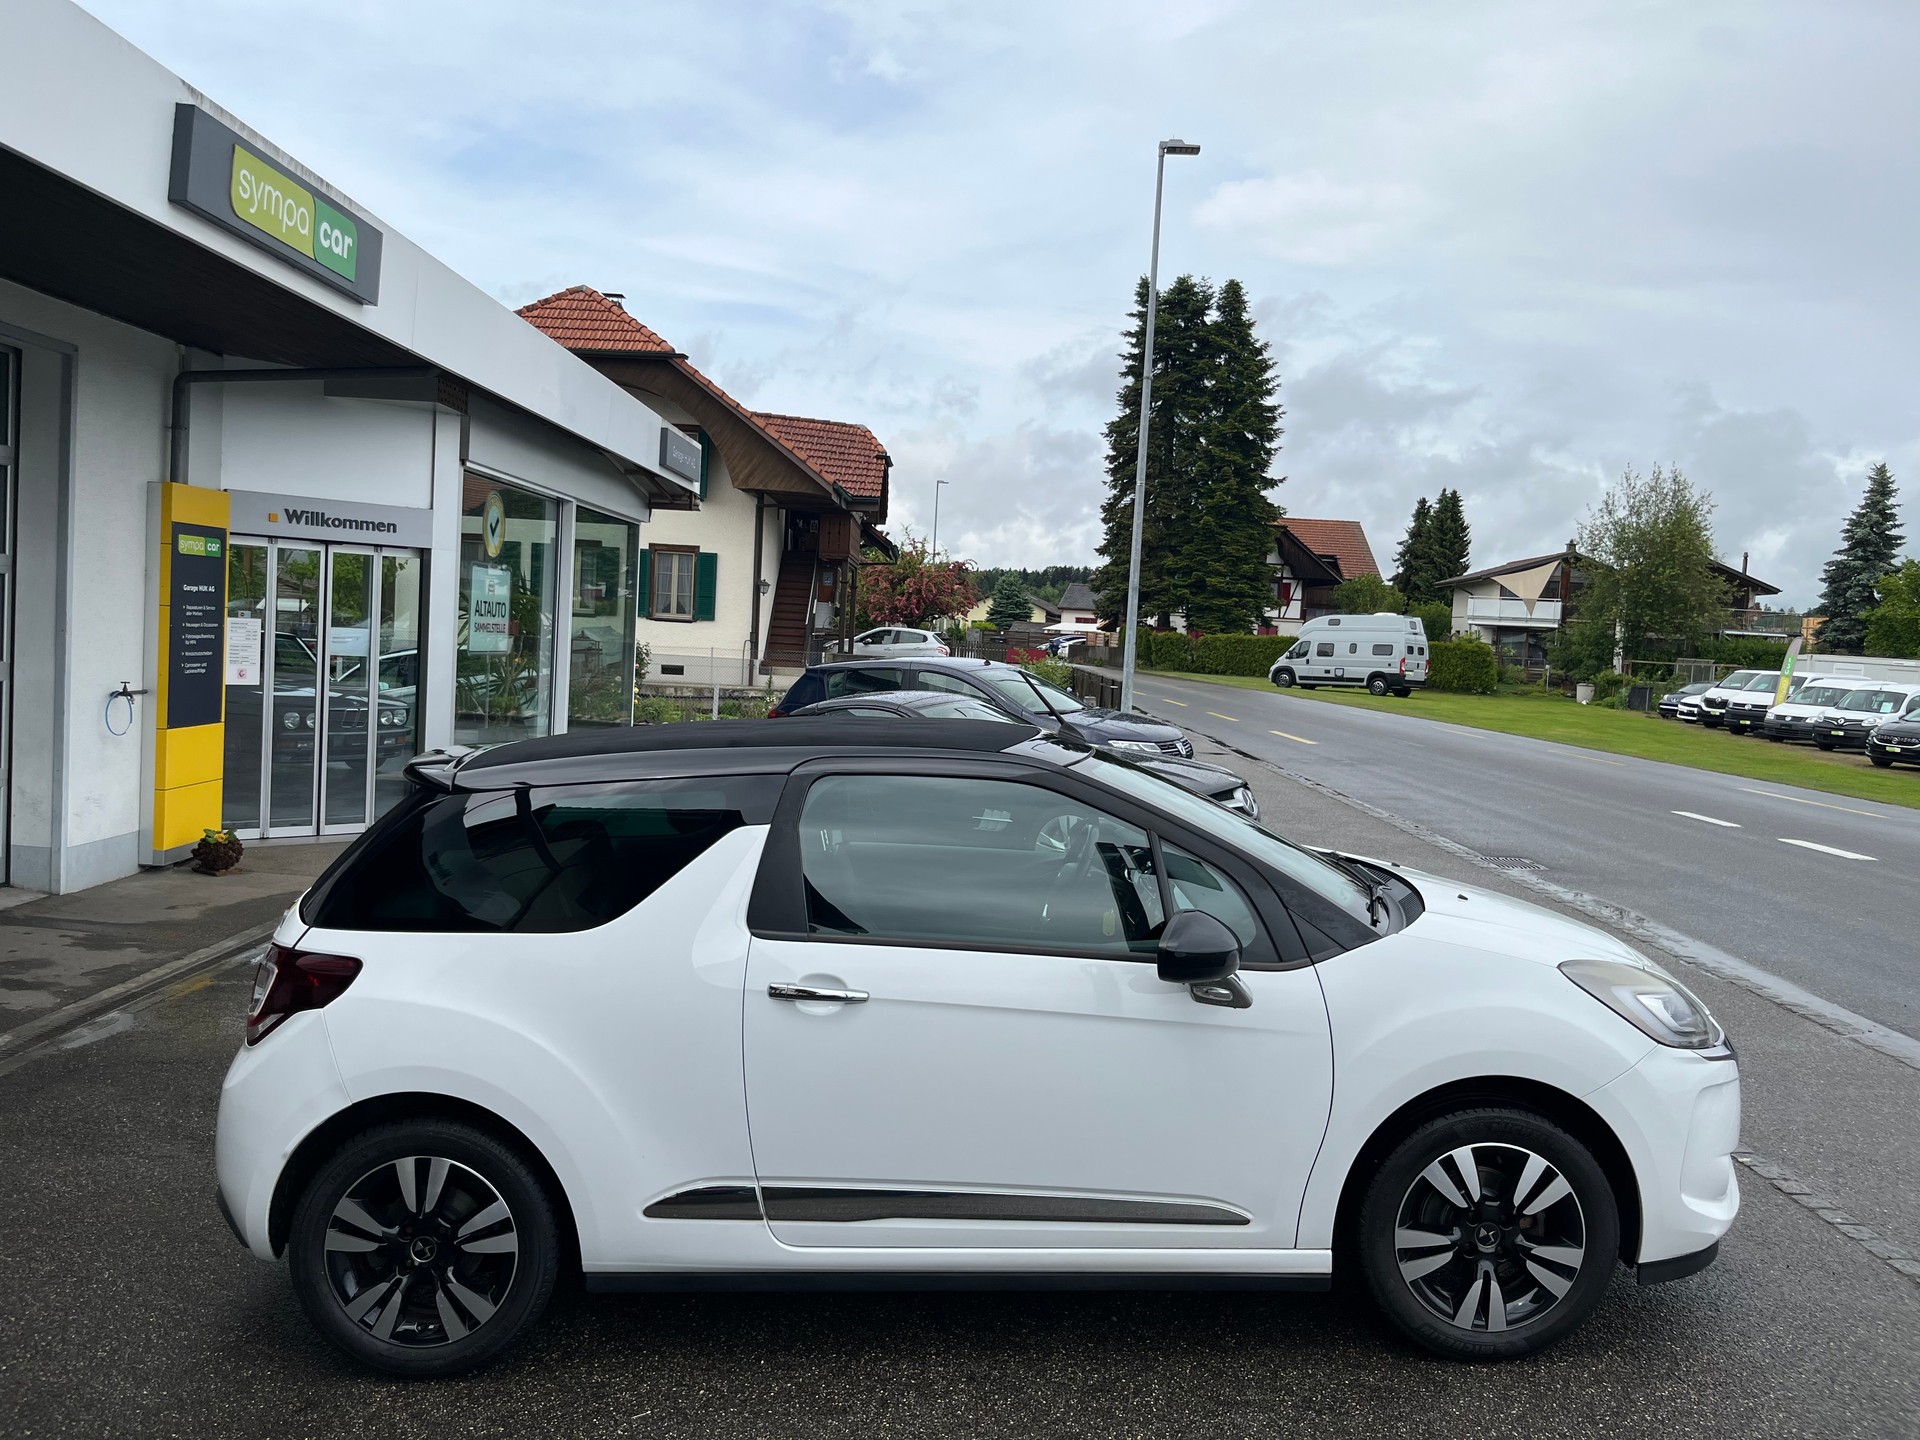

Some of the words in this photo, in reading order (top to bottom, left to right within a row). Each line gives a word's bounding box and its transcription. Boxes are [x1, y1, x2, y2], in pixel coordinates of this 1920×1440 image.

[239, 169, 309, 236] sympa
[319, 222, 353, 259] car
[284, 508, 397, 533] Willkommen
[180, 540, 204, 552] sympa
[207, 543, 220, 551] car
[475, 600, 506, 618] ALTAUTO
[474, 622, 506, 633] SAMMELSTELLE
[1418, 1323, 1494, 1355] MICHELIN
